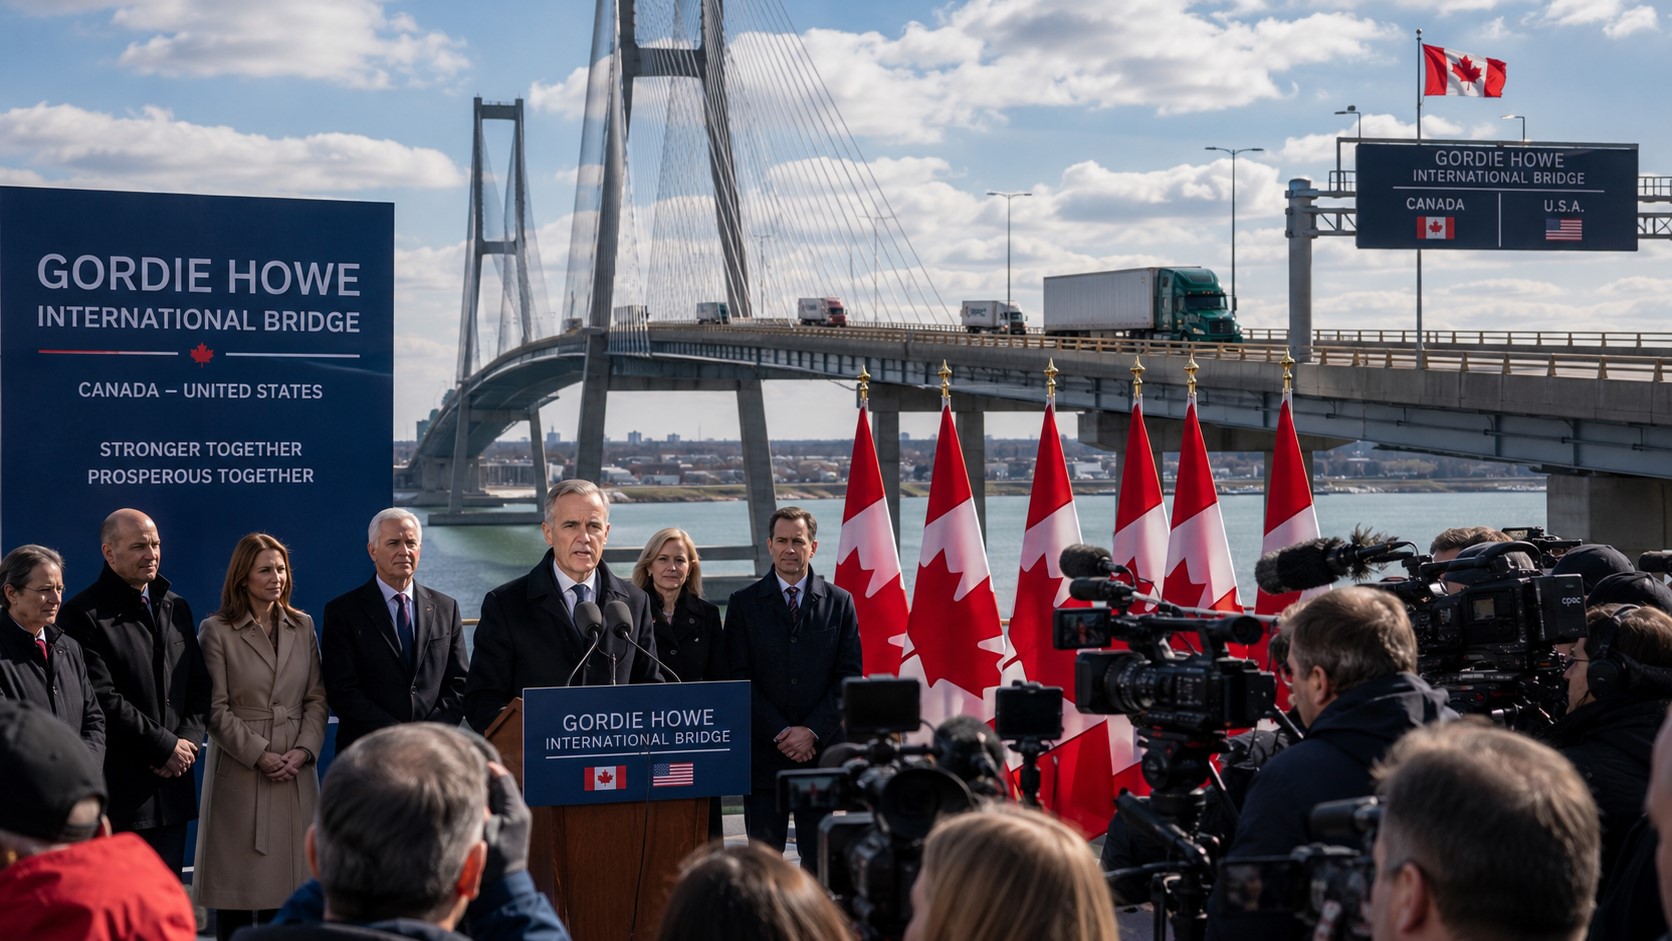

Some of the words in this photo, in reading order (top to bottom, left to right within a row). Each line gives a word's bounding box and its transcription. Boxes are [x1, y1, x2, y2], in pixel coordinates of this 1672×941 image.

[1435, 150, 1504, 168] GORDIE
[1510, 151, 1565, 169] HOWE
[1412, 169, 1529, 185] INTERNATIONAL
[1533, 171, 1586, 186] BRIDGE
[1406, 197, 1466, 211] CANADA
[1543, 199, 1586, 213] U.S.A.
[37, 252, 213, 294] GORDIE
[227, 258, 361, 297] HOWE
[37, 304, 257, 332] INTERNATIONAL
[263, 310, 361, 334] BRIDGE
[78, 381, 161, 399] CANADA
[183, 382, 252, 400] UNITED
[256, 383, 324, 400] STATES
[99, 441, 201, 457] STRONGER
[205, 440, 303, 457] TOGETHER
[87, 468, 213, 485] PROSPEROUS
[217, 467, 315, 484] TOGETHER
[562, 711, 645, 732] GORDIE
[651, 708, 715, 728] HOWE
[545, 732, 670, 751] INTERNATIONAL
[675, 729, 731, 746] BRIDGE
